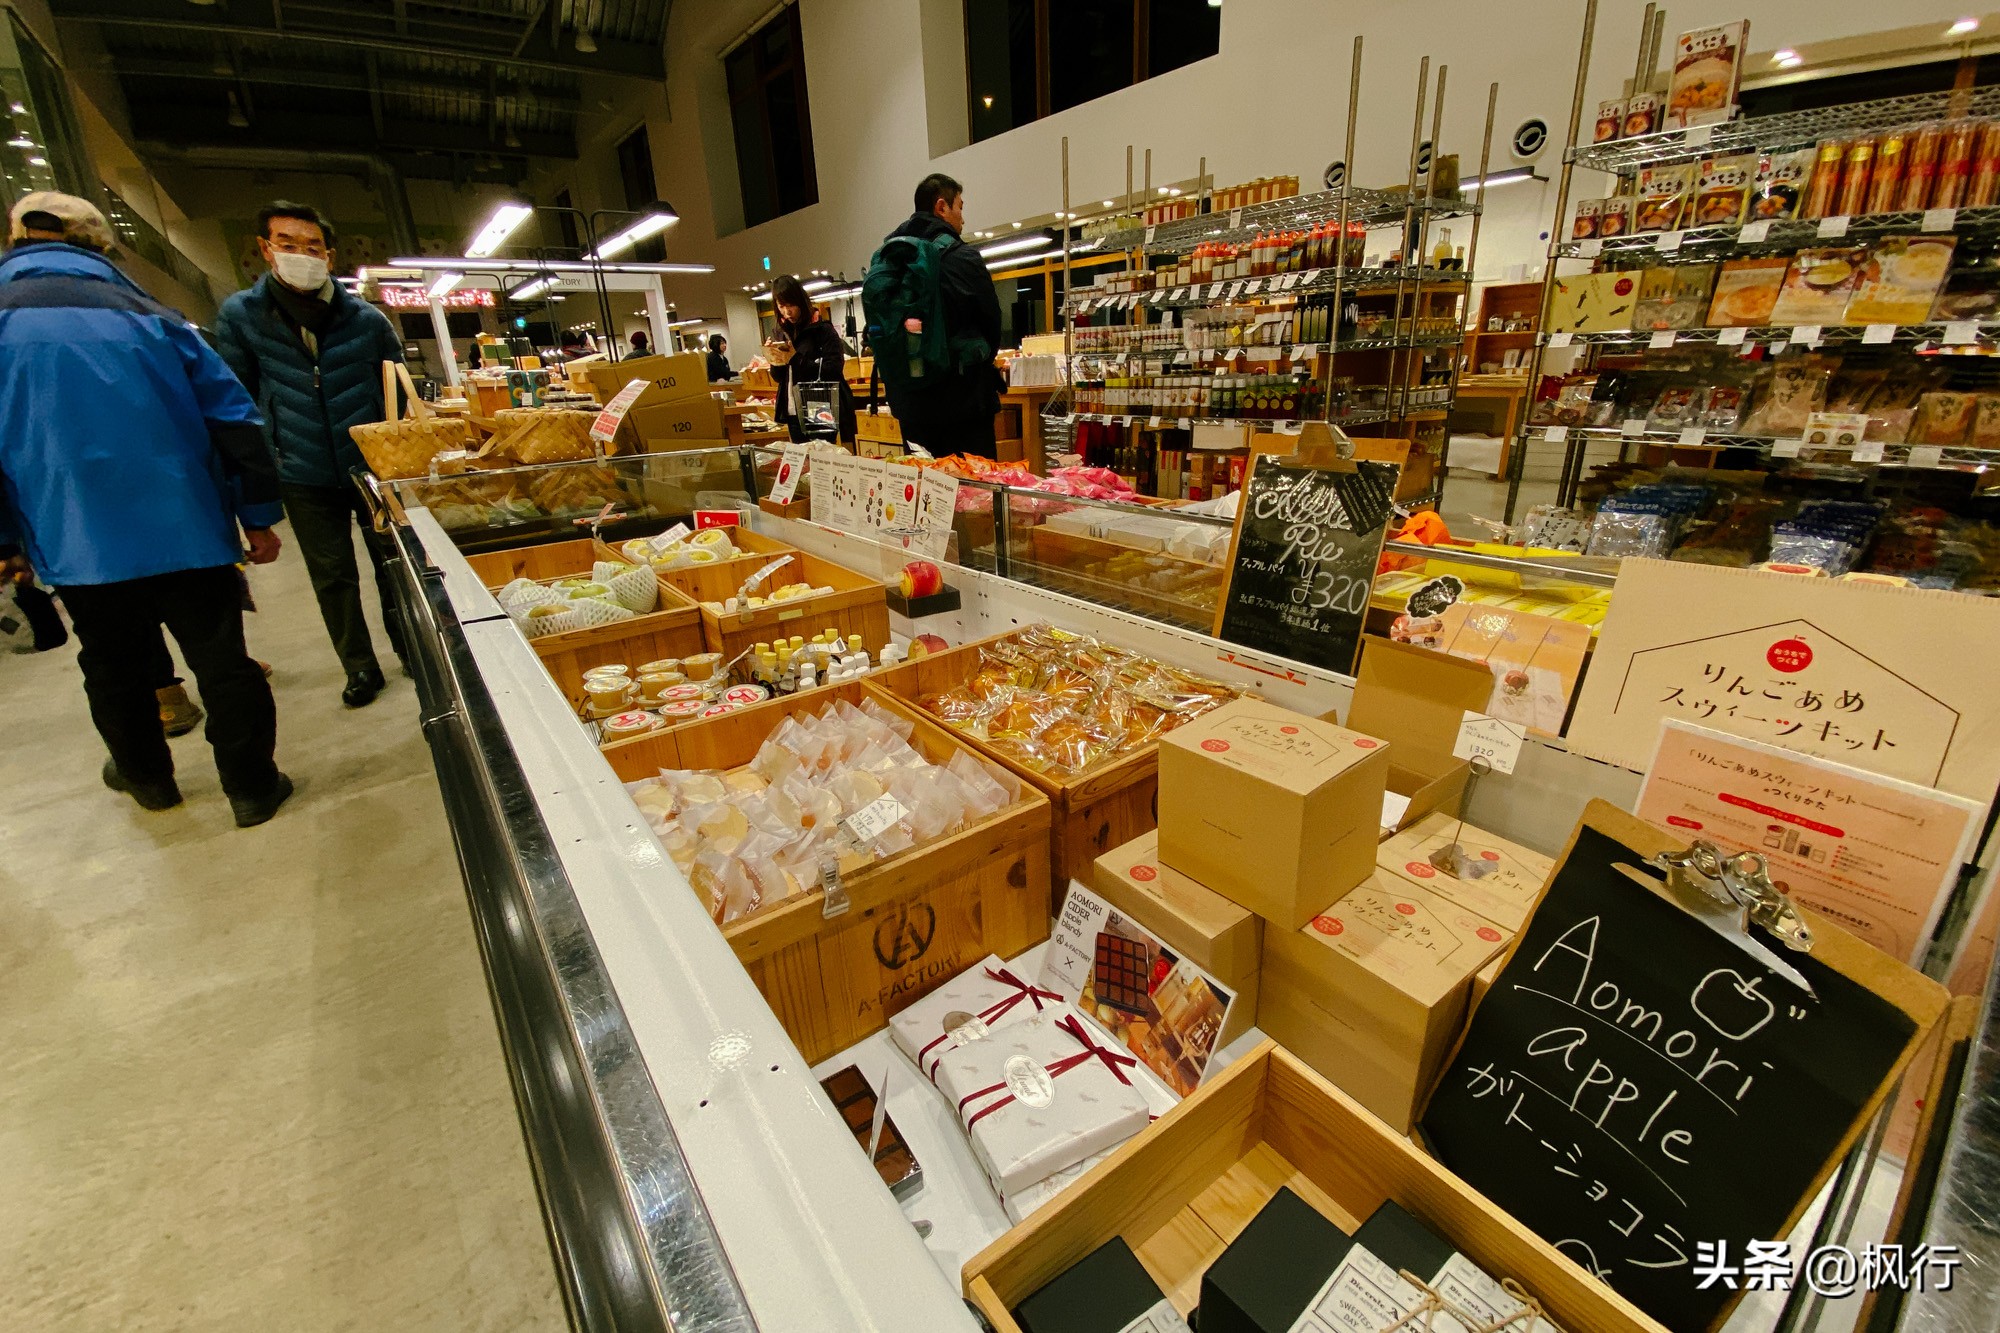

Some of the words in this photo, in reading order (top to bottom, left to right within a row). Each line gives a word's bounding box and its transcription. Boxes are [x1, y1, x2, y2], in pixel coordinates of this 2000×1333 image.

[655, 376, 676, 390] 120
[672, 421, 692, 434] 120
[1279, 523, 1343, 564] Pie
[1773, 648, 1808, 659] おうちで
[1776, 656, 1799, 667] つくる
[1703, 663, 1865, 713] りんごあめ
[1659, 686, 1897, 751] スウィーツキット
[1470, 744, 1494, 757] 1320
[1067, 900, 1091, 921] CIDER
[1070, 891, 1103, 916] AOMORI
[1064, 910, 1082, 926] apple
[1064, 941, 1092, 963] A-FACTORY
[1533, 915, 1775, 1101] Aomori
[1526, 1027, 1694, 1165] apple
[1343, 1312, 1361, 1329] DAY
